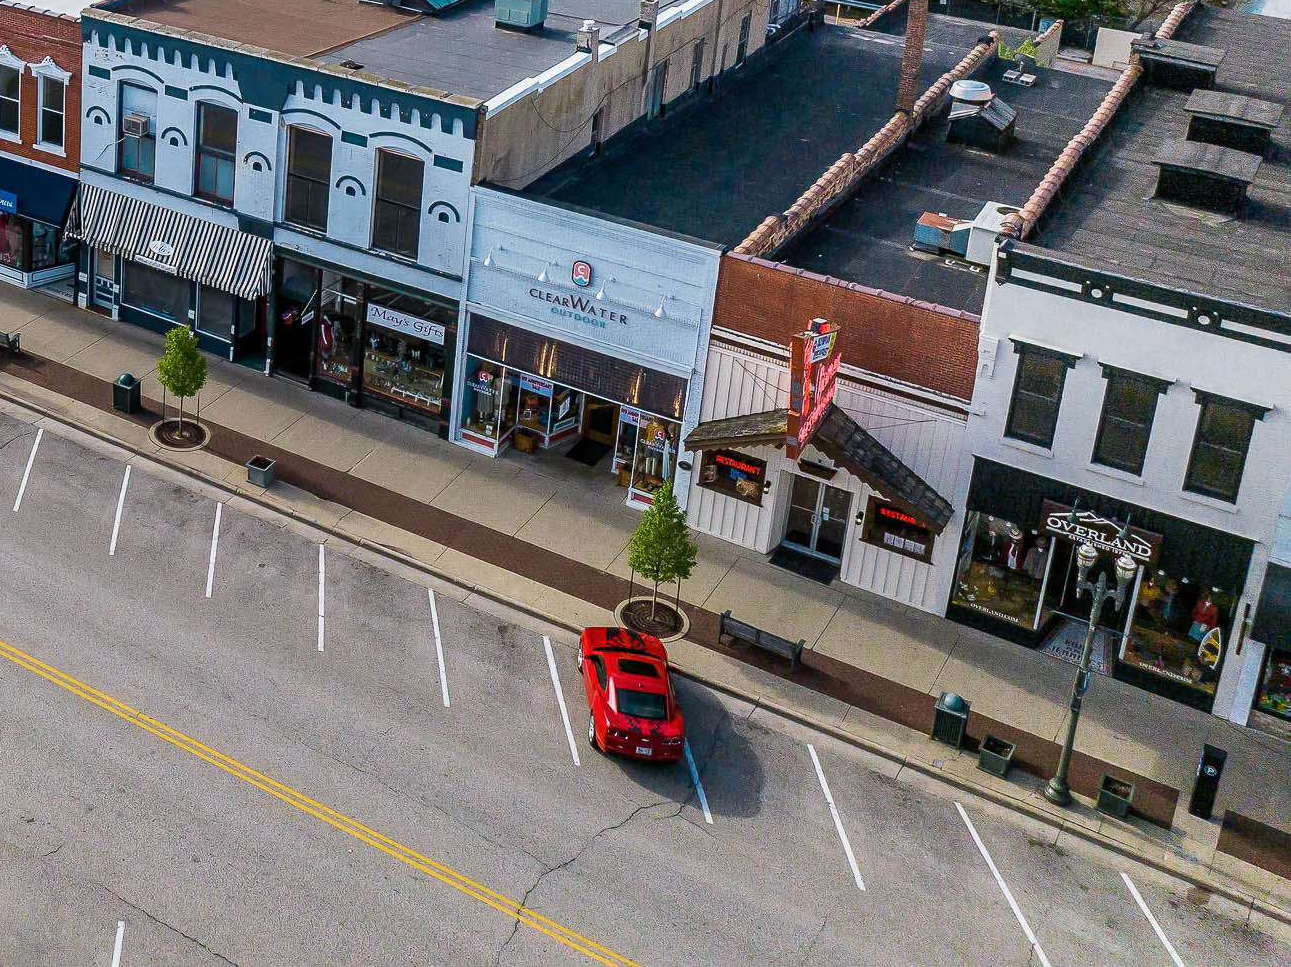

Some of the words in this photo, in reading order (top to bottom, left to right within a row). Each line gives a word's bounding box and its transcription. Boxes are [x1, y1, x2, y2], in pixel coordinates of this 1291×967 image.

[370, 306, 410, 327] May's
[413, 320, 445, 338] Gifts
[550, 306, 607, 329] OUTDOOR
[715, 454, 761, 476] RESTAURANT
[1046, 516, 1152, 557] OVERLAND
